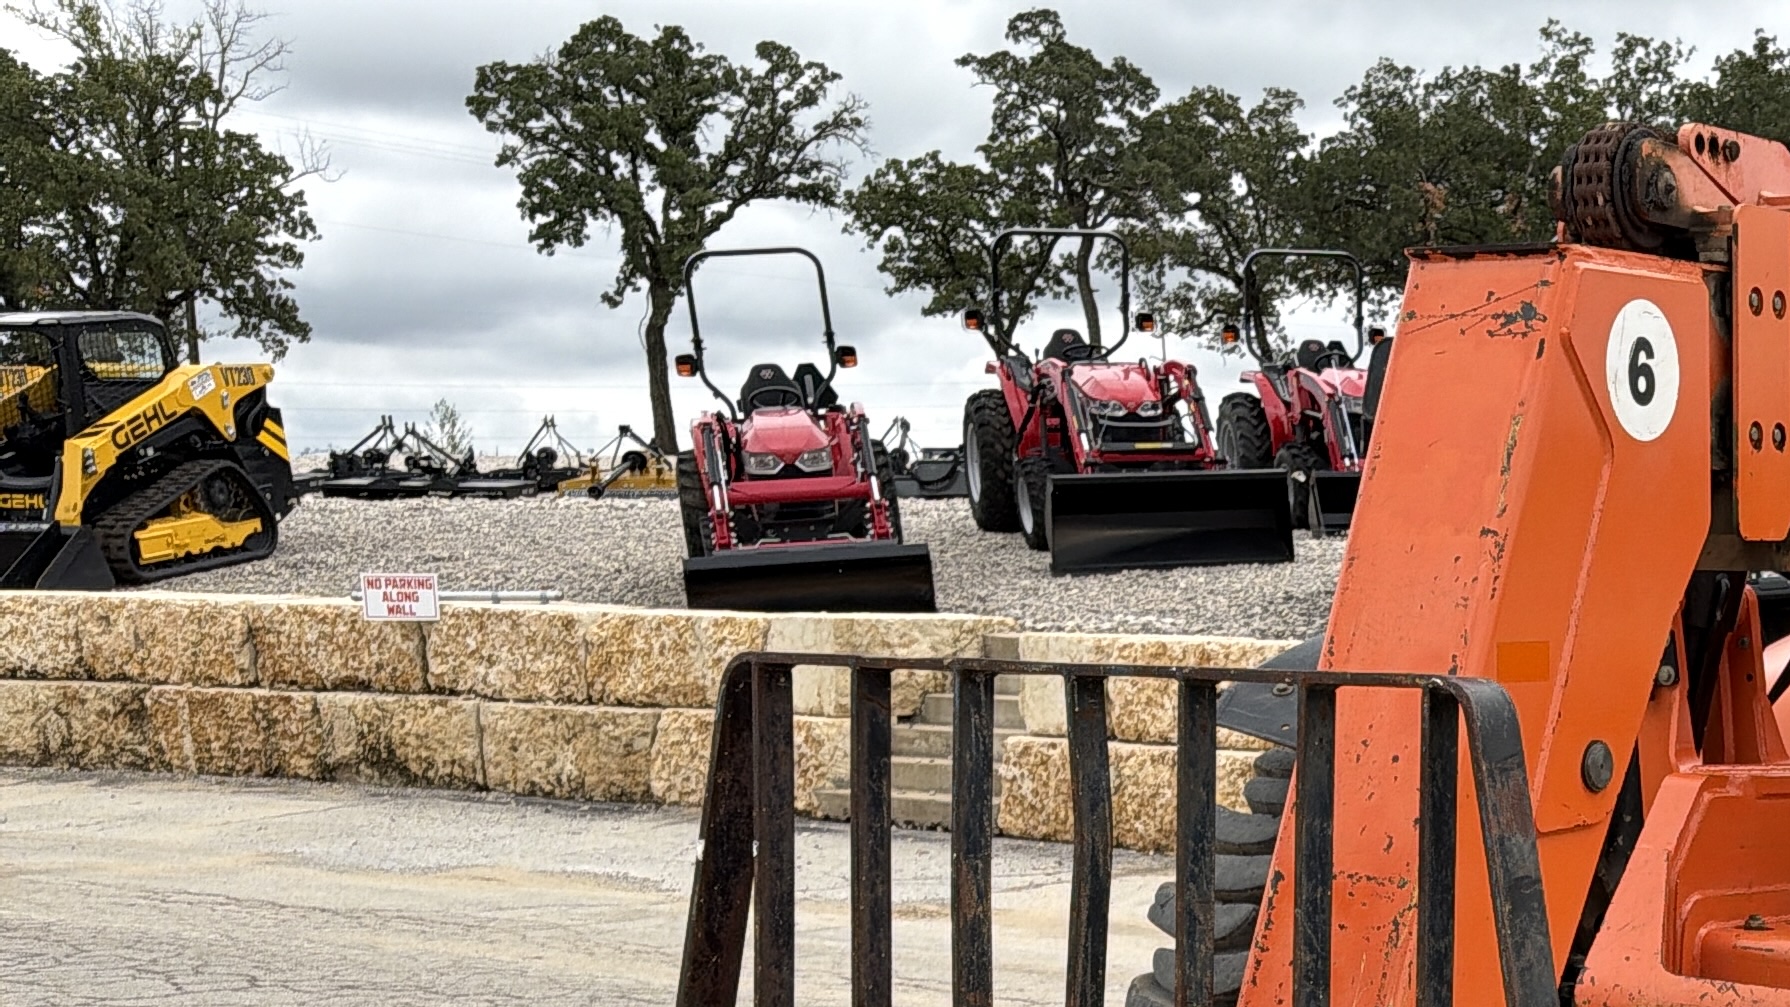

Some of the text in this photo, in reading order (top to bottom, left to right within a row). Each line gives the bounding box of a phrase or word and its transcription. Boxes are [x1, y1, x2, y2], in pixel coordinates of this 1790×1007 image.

[219, 367, 256, 387] VT230
[1628, 336, 1656, 406] 6
[111, 400, 178, 450] GEHL
[367, 578, 433, 590] NO PARKING
[382, 591, 420, 602] ALONG
[387, 603, 417, 616] WALL
